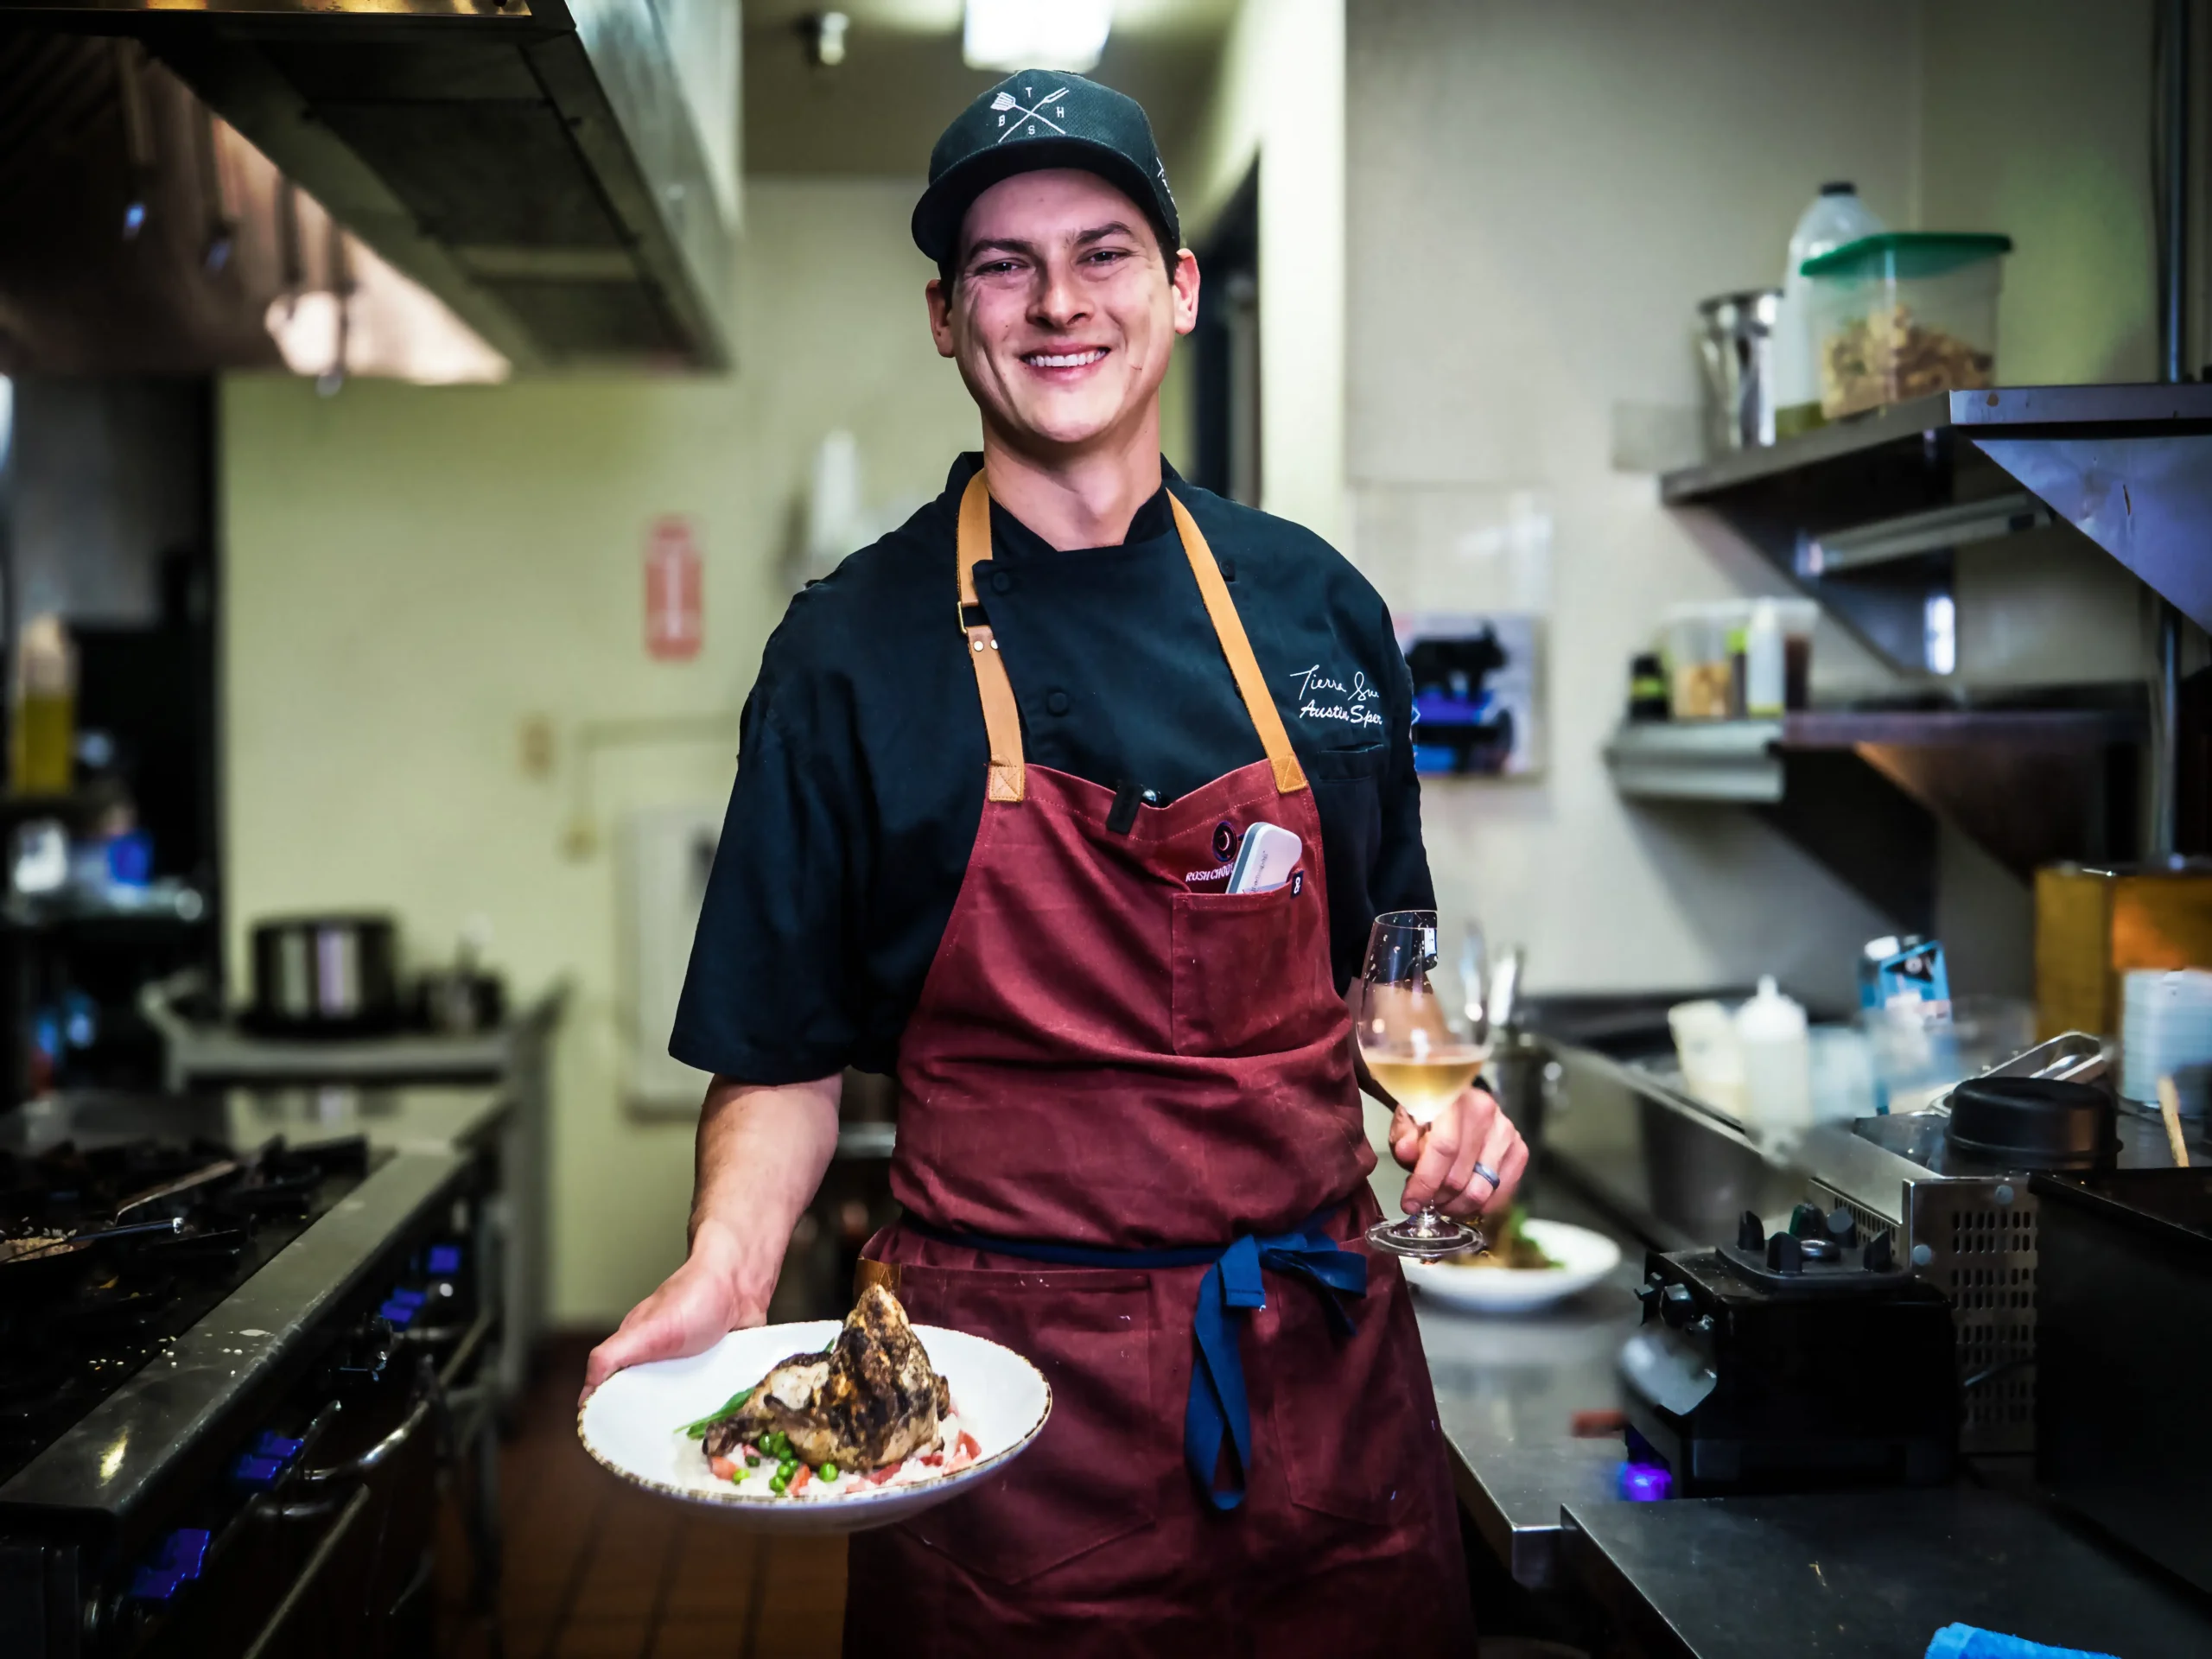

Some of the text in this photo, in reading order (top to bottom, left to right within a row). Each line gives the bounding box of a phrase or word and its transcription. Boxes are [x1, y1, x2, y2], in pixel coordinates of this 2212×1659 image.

[1025, 86, 1033, 99] T
[1056, 106, 1065, 118] H
[998, 114, 1006, 127] B
[1027, 124, 1036, 135] S
[1299, 699, 1350, 721] Austin
[1185, 870, 1211, 882] ROSH
[1294, 876, 1301, 894] &
